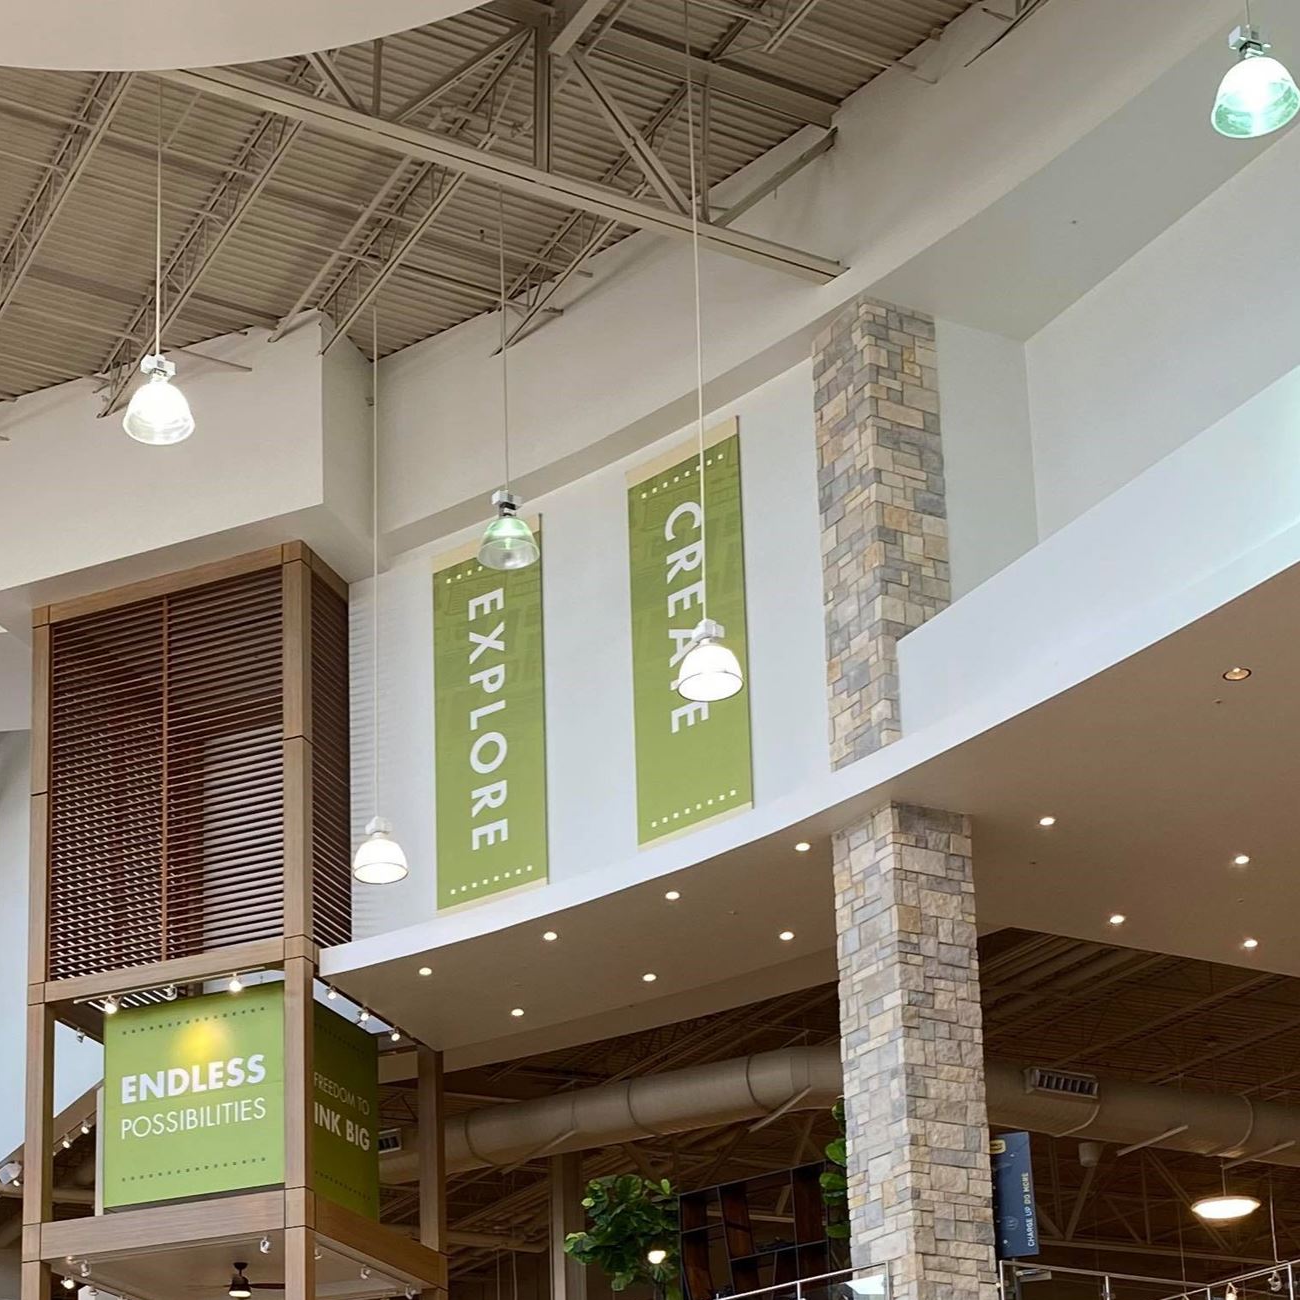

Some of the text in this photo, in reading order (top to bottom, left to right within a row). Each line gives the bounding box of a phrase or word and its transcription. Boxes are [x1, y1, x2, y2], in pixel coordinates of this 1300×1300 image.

[664, 501, 709, 734] CREAE
[468, 586, 509, 851] EXPLORE
[121, 1053, 267, 1105] ENDLESS
[313, 1071, 370, 1116] FREEDOM TO
[121, 1097, 267, 1140] POSSIBILITIES
[313, 1101, 370, 1152] INK BIG
[1023, 1193, 1032, 1205] DO
[1024, 1206, 1033, 1217] UP
[1026, 1218, 1035, 1247] CHARGE
